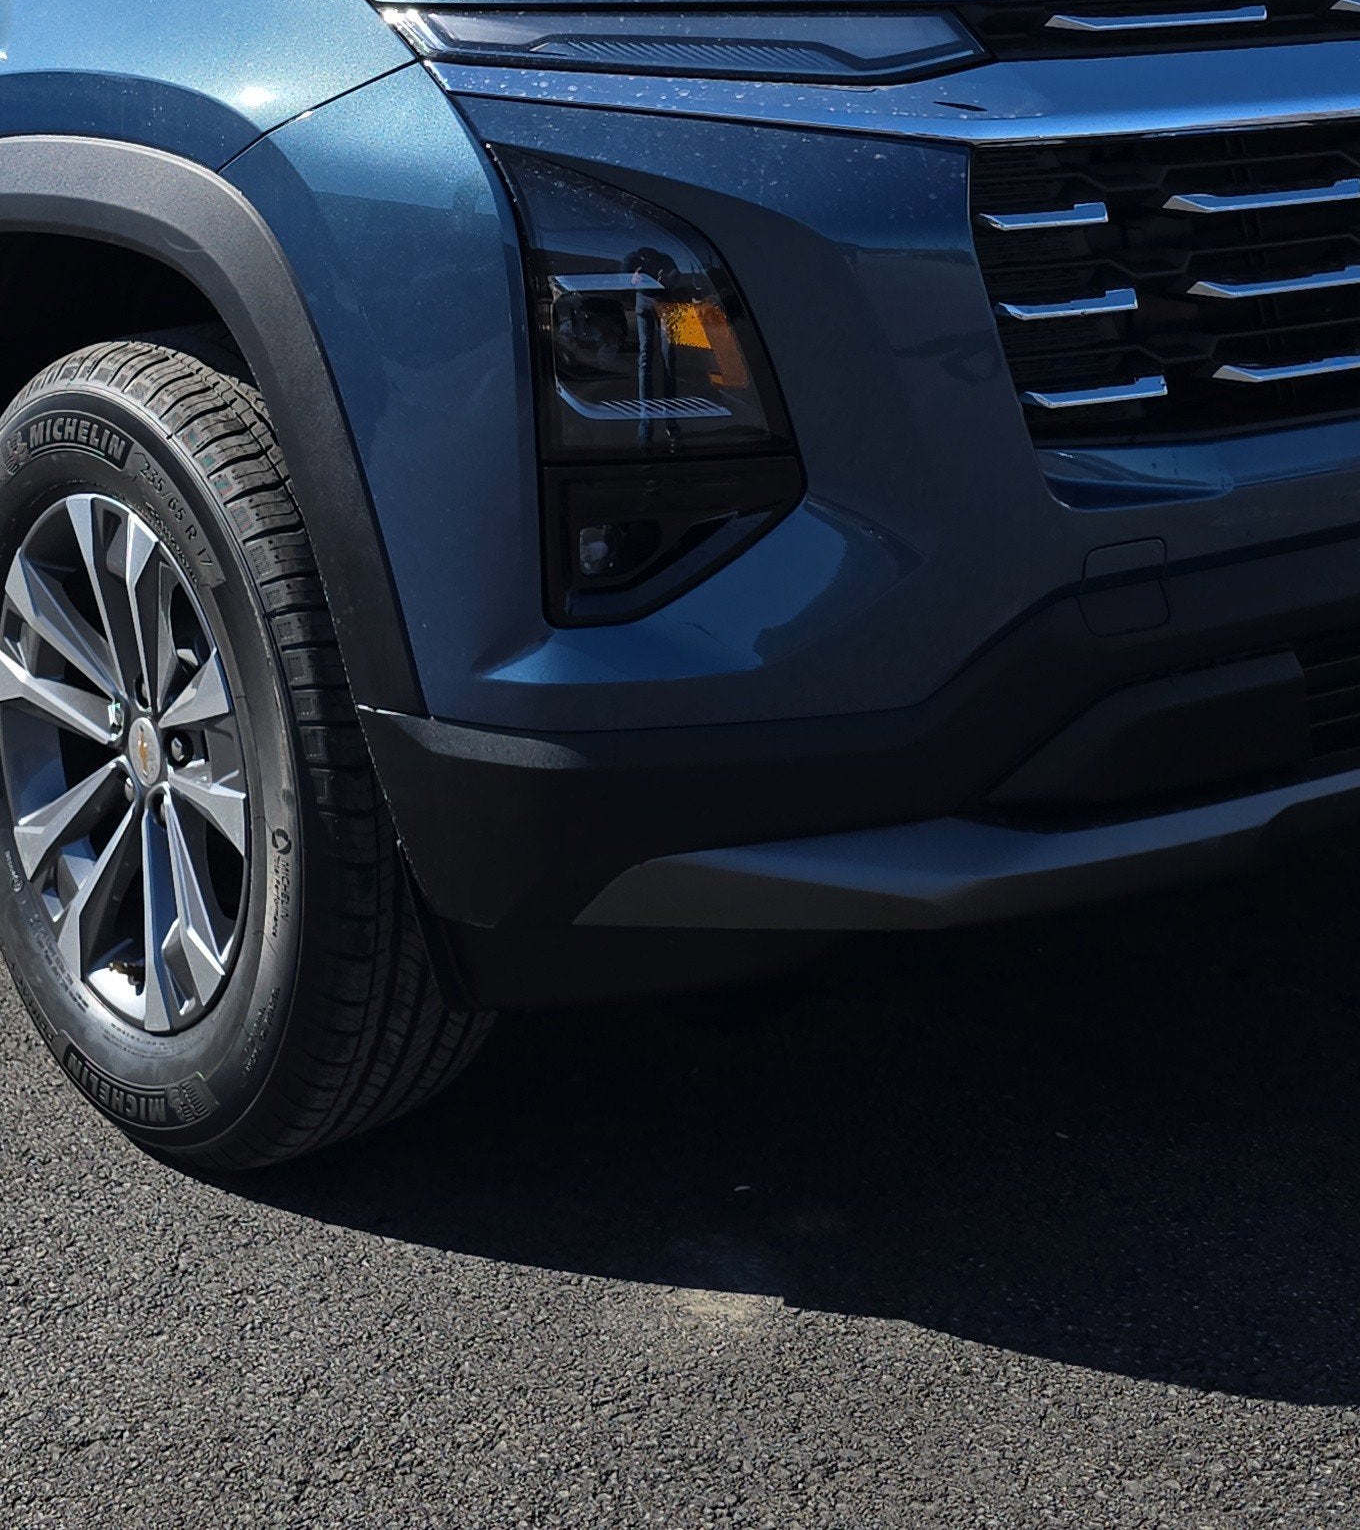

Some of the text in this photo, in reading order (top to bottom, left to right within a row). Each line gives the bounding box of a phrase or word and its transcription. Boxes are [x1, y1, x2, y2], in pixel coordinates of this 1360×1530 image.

[29, 417, 127, 462] MICHELIN
[185, 525, 198, 541] R
[196, 547, 215, 567] 17
[66, 1051, 167, 1121] MICHELIN
